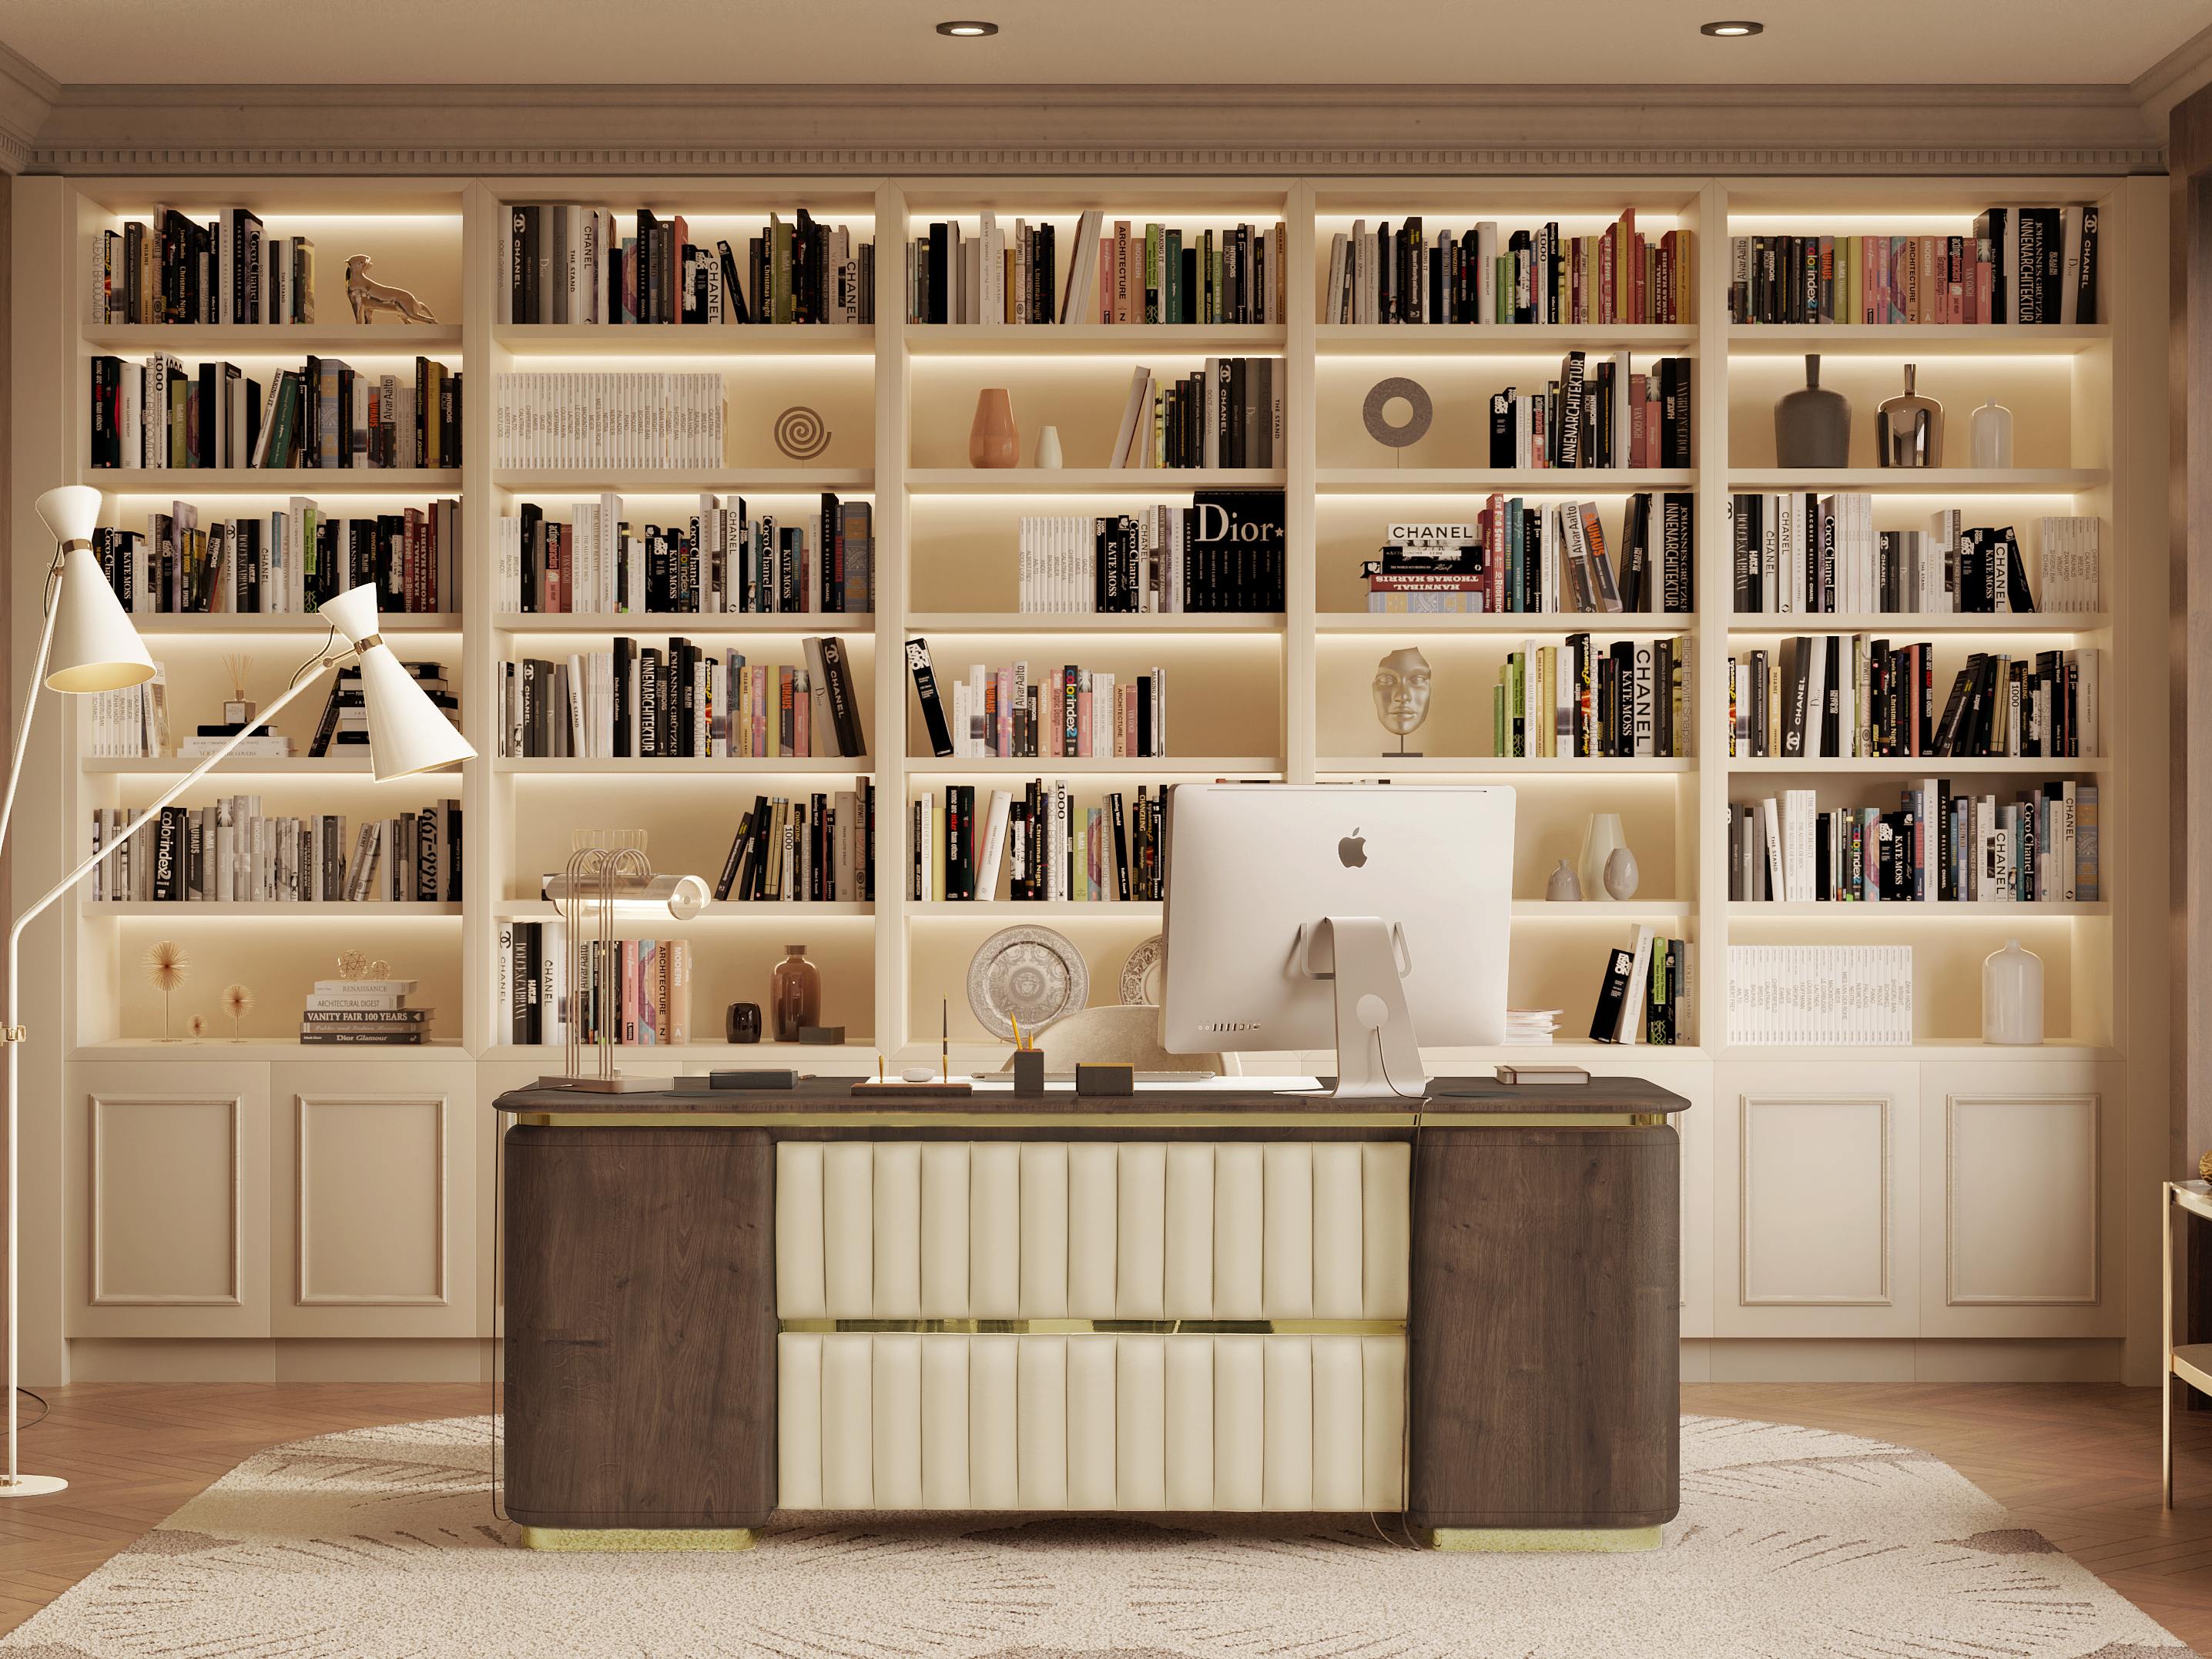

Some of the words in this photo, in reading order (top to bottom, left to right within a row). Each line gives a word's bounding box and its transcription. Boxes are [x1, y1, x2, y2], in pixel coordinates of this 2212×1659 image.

[250, 232, 260, 260] Coco
[584, 226, 592, 270] CHANEL
[1159, 254, 1165, 263] IT
[539, 258, 549, 277] Dior
[2020, 218, 2034, 321] INNENARCHITEKTUR
[2068, 258, 2078, 277] Dior
[2082, 240, 2090, 289] CHANEL
[250, 262, 260, 303] Chanel
[709, 261, 719, 323] CHANEL
[847, 262, 856, 323] CHANEL
[270, 372, 280, 397] MAKING
[267, 398, 273, 407] IT
[1245, 407, 1256, 424] Dior
[1561, 359, 1584, 463] INNENARCHITEKTUR
[690, 518, 699, 545] Coco
[763, 518, 772, 545] Coco
[1129, 520, 1138, 549] Coco
[1195, 504, 1274, 541] Dior
[1393, 527, 1473, 538] CHANEL
[1584, 512, 1604, 557] BAUHAUS
[1825, 516, 1834, 545] Coco
[123, 552, 132, 575] KATE
[689, 546, 699, 588] Chanel
[762, 546, 772, 588] Chanel
[1108, 542, 1117, 568] KATE
[1129, 550, 1138, 589] Chanel
[1665, 503, 1677, 607] INNENARCHITEKTUR
[1748, 551, 1758, 575] HATJE
[1825, 547, 1834, 588] Chanel
[1108, 570, 1117, 597] MOSS
[1680, 561, 1688, 612] GRÜTZKE
[1996, 546, 2005, 608] CHANEL
[782, 674, 793, 709] BAUHAUS
[815, 687, 825, 706] Dior
[831, 670, 844, 719] CHANEL
[986, 681, 996, 713] BAUHAUS
[1054, 689, 1062, 708] Graphic
[1622, 670, 1632, 701] KATE
[1637, 649, 1651, 746] CHANEL
[1795, 676, 1805, 725] CHANEL
[642, 657, 655, 751] INNENARCHITEKTUR
[1054, 709, 1062, 726] Design
[1623, 705, 1632, 736] MOSS
[2024, 803, 2033, 832] Coco
[190, 819, 199, 853] BAUHAUS
[1895, 836, 1903, 859] KATE
[1996, 833, 2006, 894] CHANEL
[2024, 833, 2034, 874] Chanel
[1895, 861, 1903, 885] MOSS
[528, 979, 536, 1004] HATJE
[545, 960, 553, 1007] CHANEL
